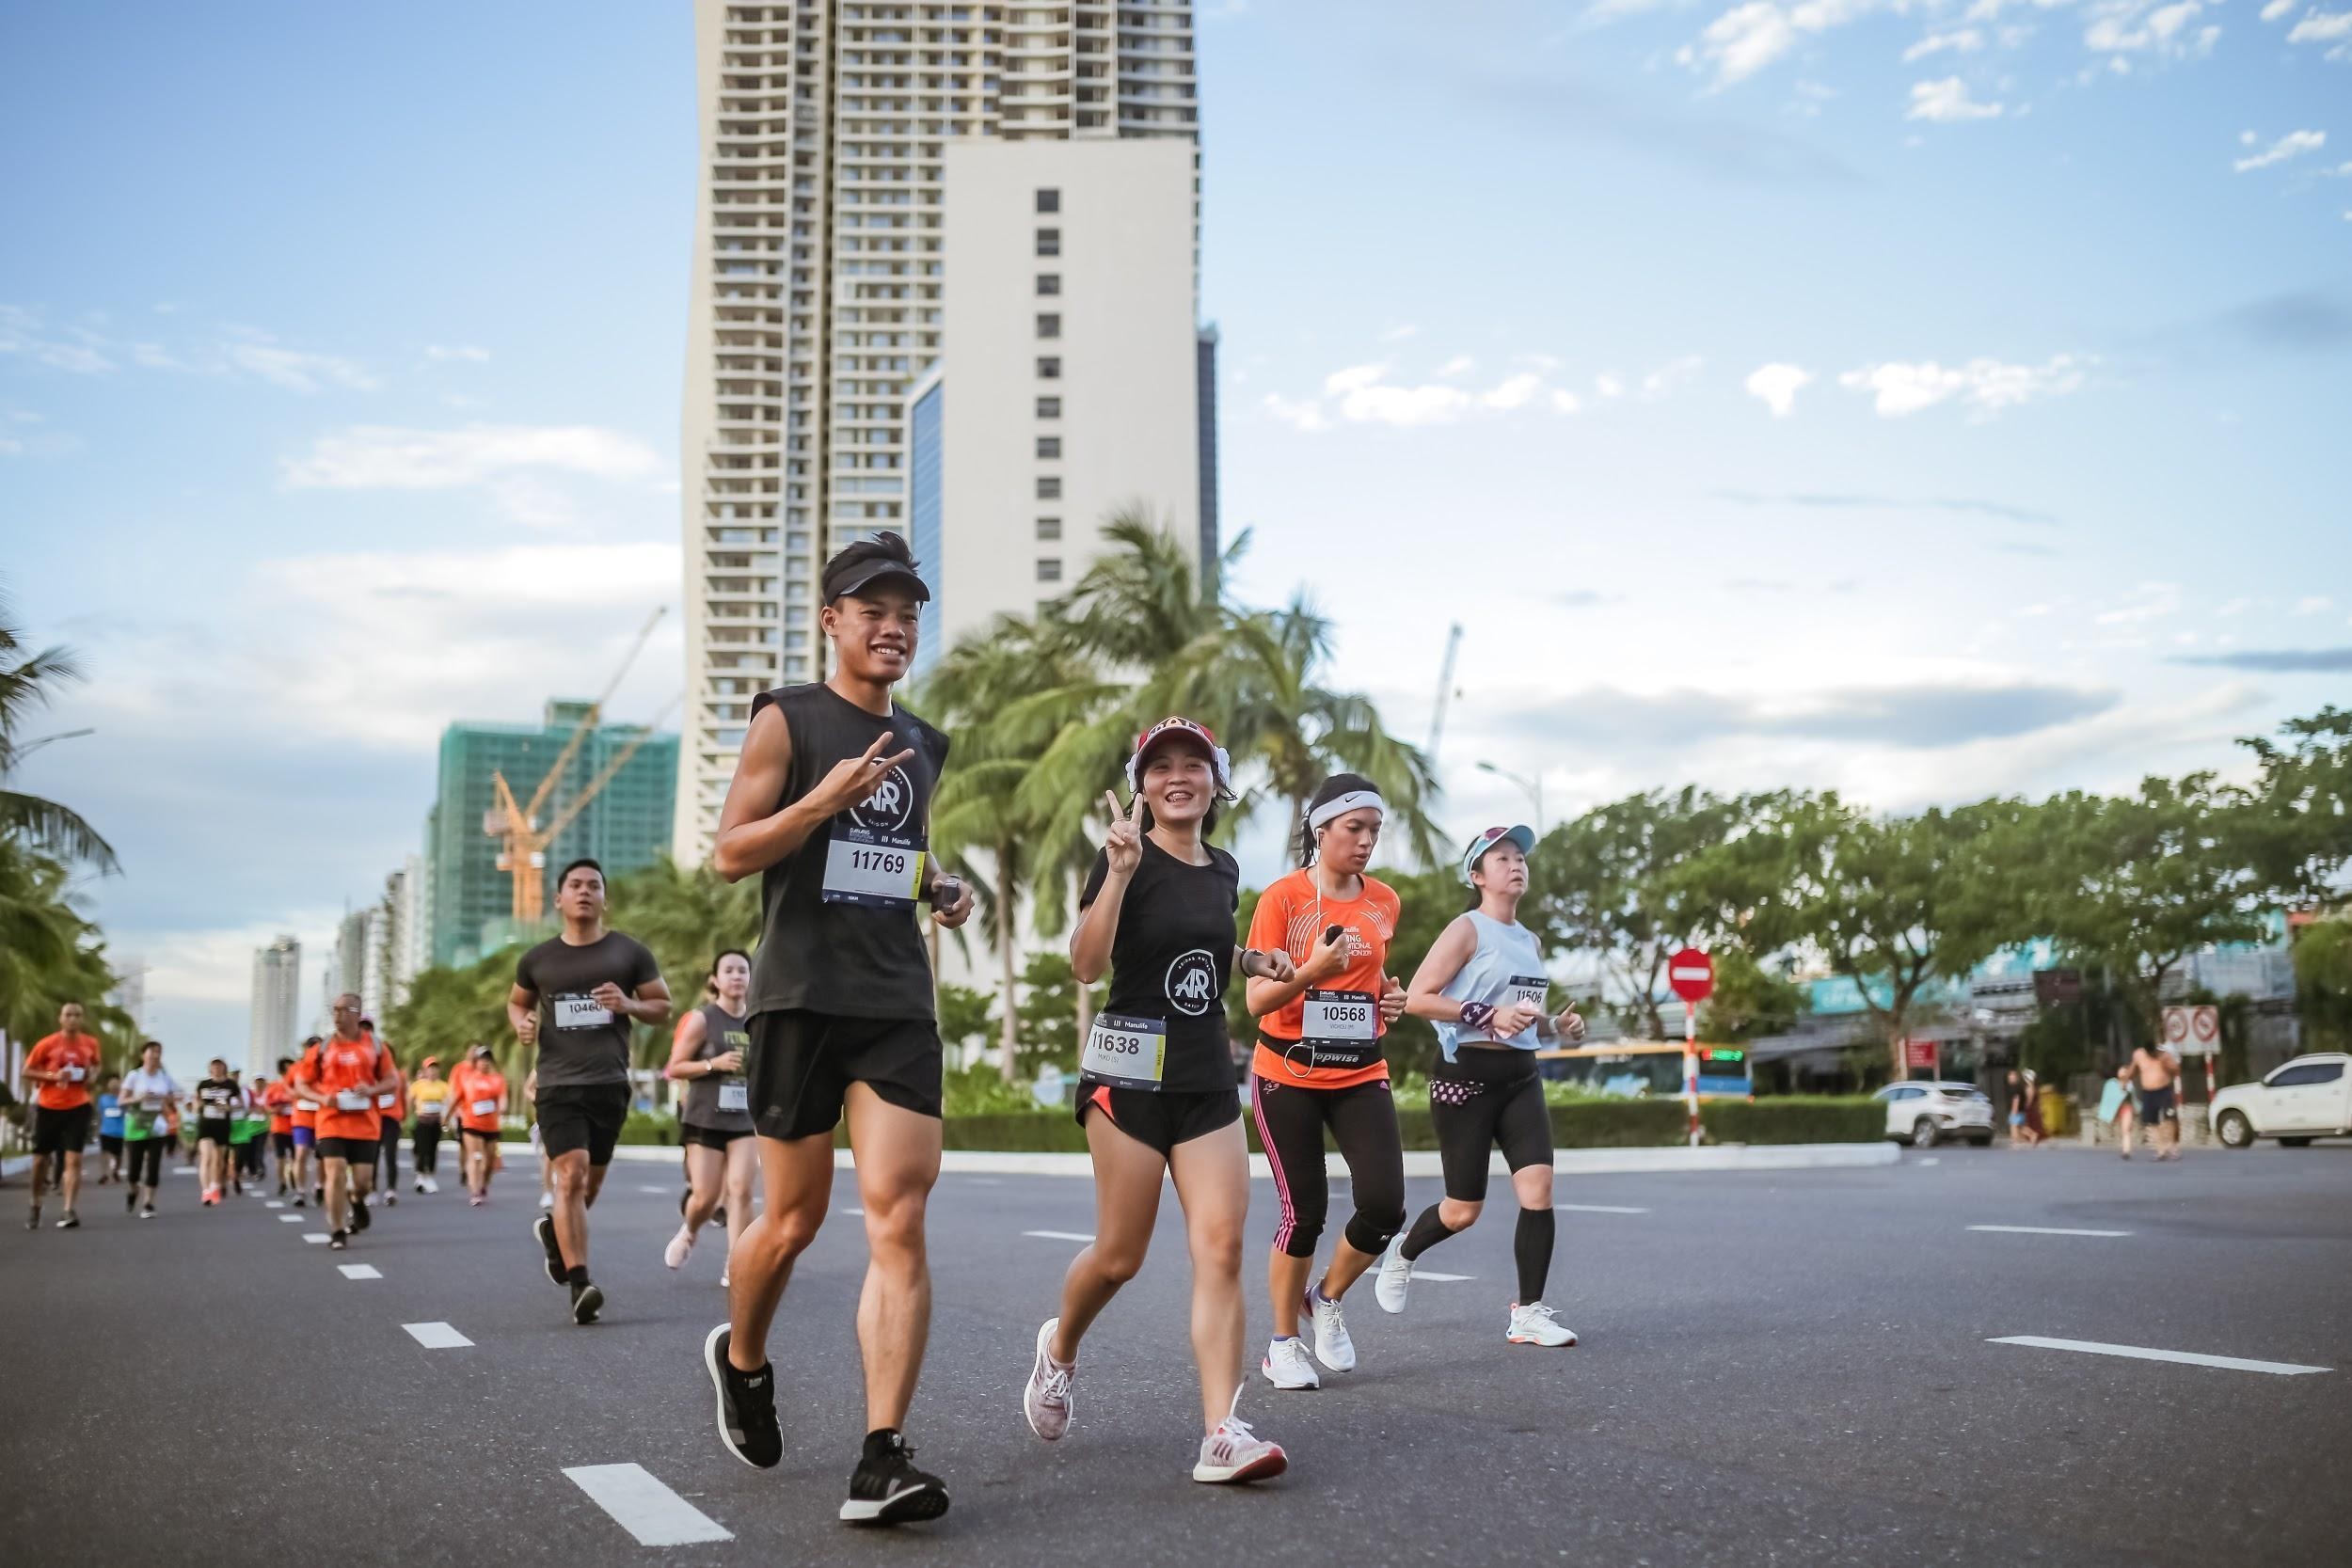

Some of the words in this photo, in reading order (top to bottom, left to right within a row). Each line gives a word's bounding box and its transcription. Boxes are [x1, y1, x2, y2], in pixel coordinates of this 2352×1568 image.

[859, 780, 900, 816] AR
[891, 836, 912, 846] Manulife
[851, 849, 905, 875] 11769
[1174, 968, 1211, 1000] AR
[1517, 990, 1543, 1005] 11506
[1322, 1006, 1366, 1022] 10568
[1124, 1022, 1149, 1030] Manulife
[1092, 1031, 1140, 1055] 11638
